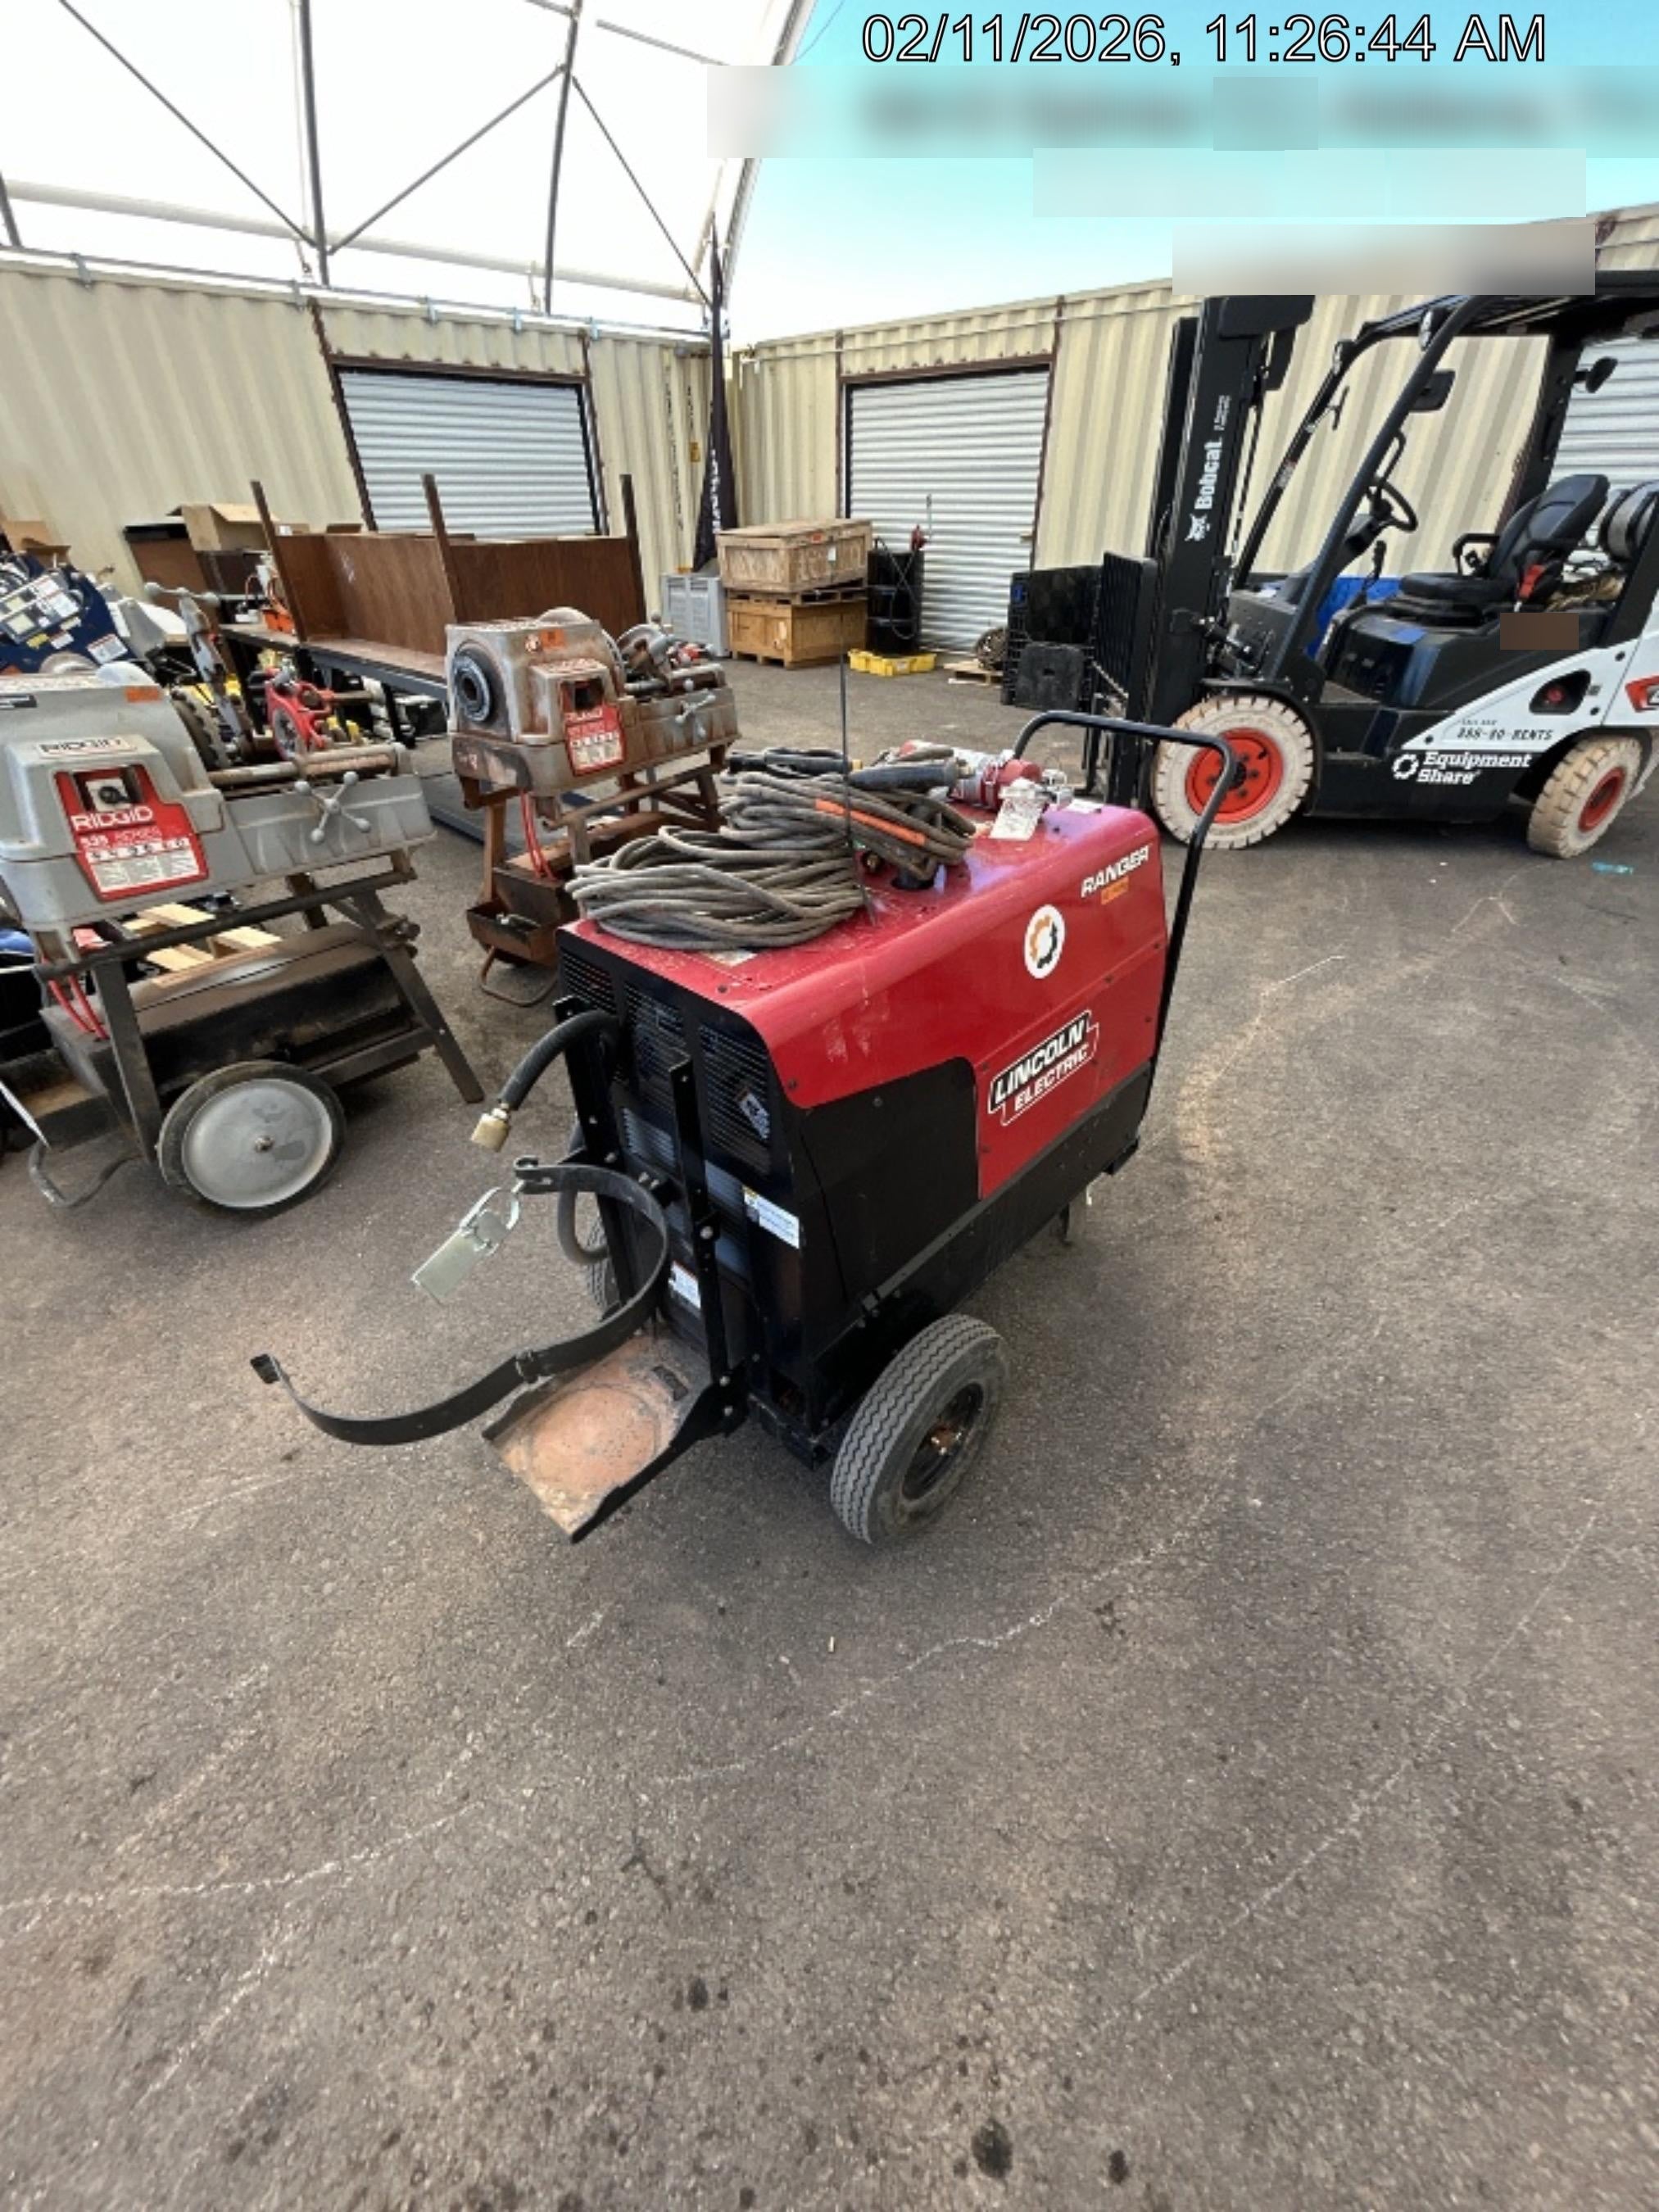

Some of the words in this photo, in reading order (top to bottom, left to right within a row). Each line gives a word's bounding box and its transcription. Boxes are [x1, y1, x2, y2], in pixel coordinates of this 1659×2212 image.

[1194, 436, 1222, 510] Bobcat
[1422, 751, 1532, 769] Equipment
[70, 805, 153, 832] RIDGID
[1081, 844, 1151, 898] RANGER
[995, 1018, 1086, 1105] LINCOLN
[1014, 1043, 1090, 1112] ELECTRIC
